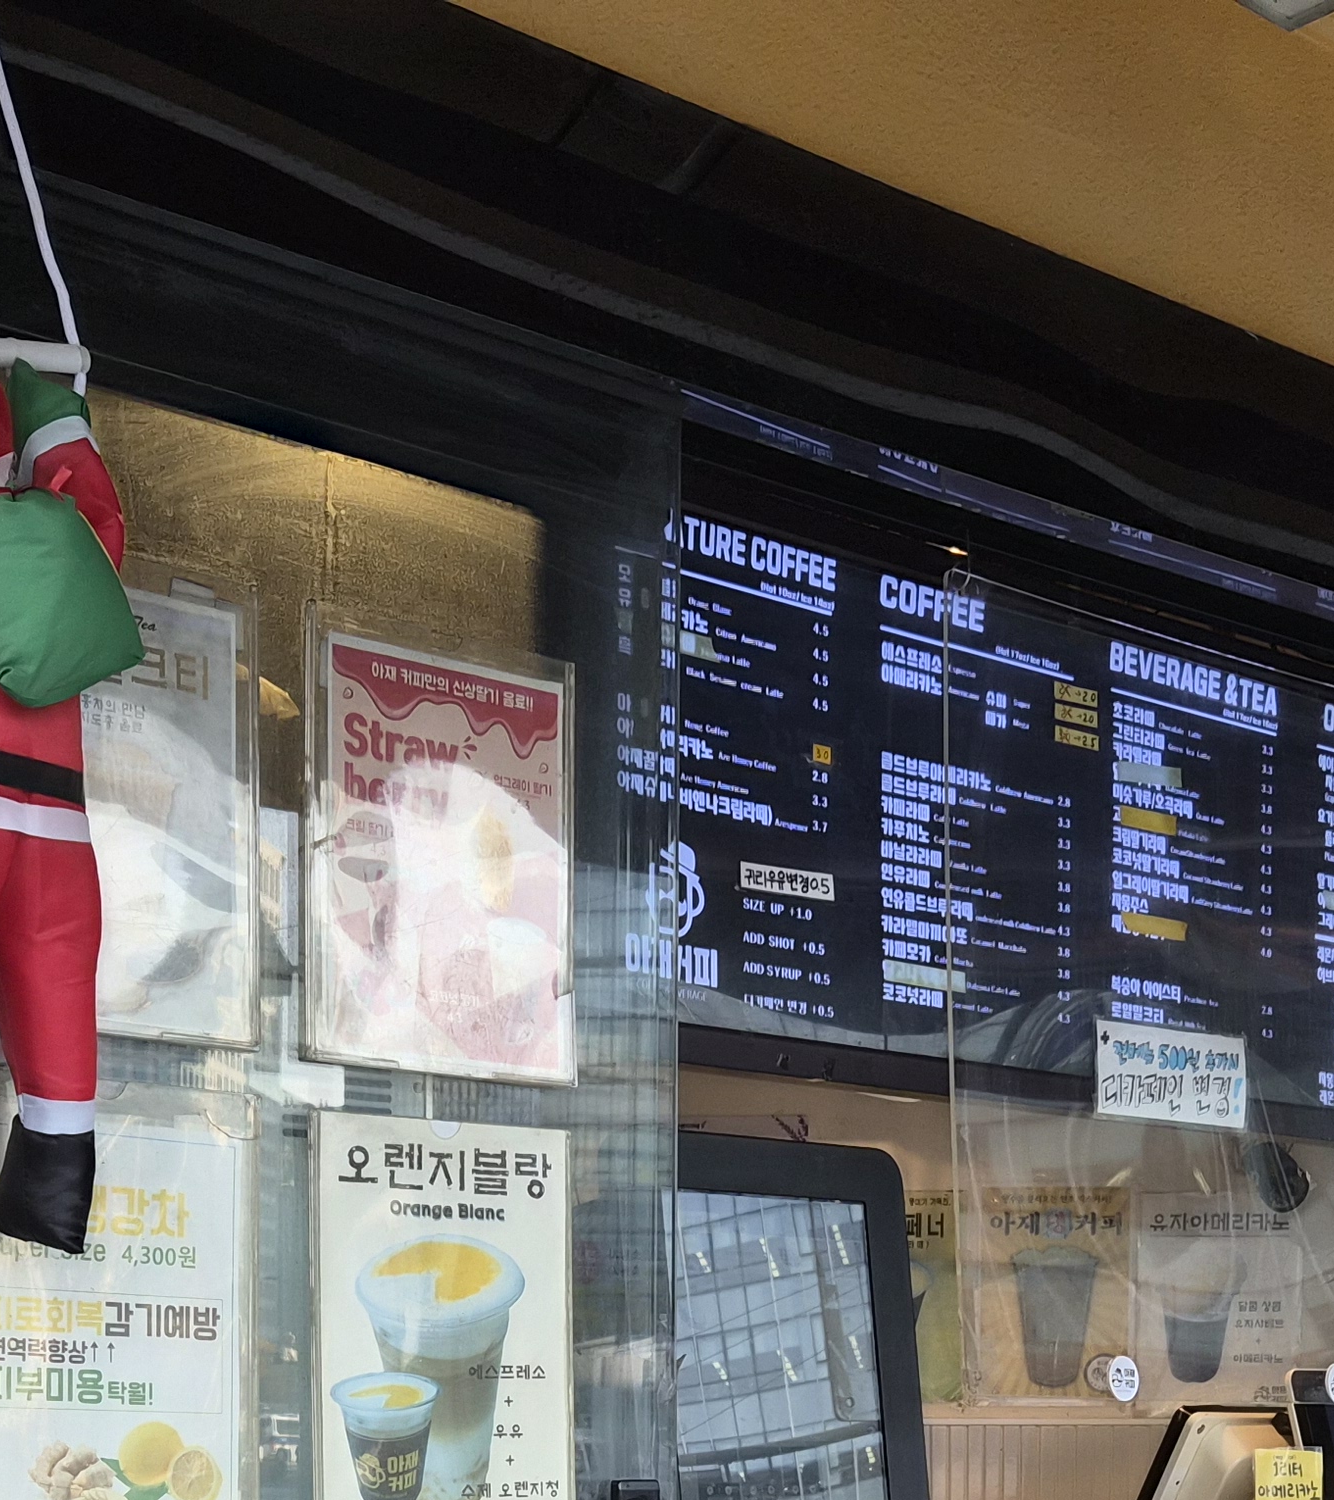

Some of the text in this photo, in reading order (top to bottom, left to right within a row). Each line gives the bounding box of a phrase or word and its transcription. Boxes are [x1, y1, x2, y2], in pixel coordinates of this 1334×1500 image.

[751, 537, 837, 594] COFFEE
[879, 573, 986, 634] COFFEE
[812, 622, 829, 638] 4.5
[812, 647, 829, 663] 4.5
[881, 640, 943, 675] 에스프레소
[812, 672, 829, 688] 4.5
[881, 662, 943, 697] 아메리카노
[1109, 640, 1222, 701] BEVERAGE
[371, 661, 397, 682] 아재
[400, 668, 449, 694] 커피만의
[452, 680, 499, 706] 신상딸기
[812, 697, 829, 713] 4.5
[1113, 701, 1155, 727] 초코라떼
[343, 712, 459, 770] Straw
[1113, 721, 1165, 750] 그린티라떼
[812, 795, 828, 809] 3.3
[812, 819, 828, 833] 3.7
[881, 818, 929, 844] 카푸치노
[743, 897, 785, 917] SIZE UP
[743, 930, 796, 952] ADD SHOT
[743, 961, 803, 983] ADD SYRUP
[1142, 980, 1181, 1004] 아이스티
[1158, 1043, 1201, 1073] 500원
[1101, 1073, 1183, 1117] 디카페인
[337, 1142, 553, 1200] 오렌지블랑
[388, 1199, 506, 1223] Orange Blanc
[1149, 1211, 1291, 1233] 유자아메리카노
[990, 1210, 1040, 1237] 아재
[120, 1244, 197, 1270] 4,300원
[468, 1364, 547, 1381] 에스프레소
[107, 1381, 154, 1406] 탁월!
[493, 1423, 524, 1440] 우유
[387, 1450, 419, 1474] 아재
[1273, 1461, 1303, 1478] 1리터
[387, 1474, 417, 1493] 커피
[460, 1479, 560, 1500] 수제 오렌지청
